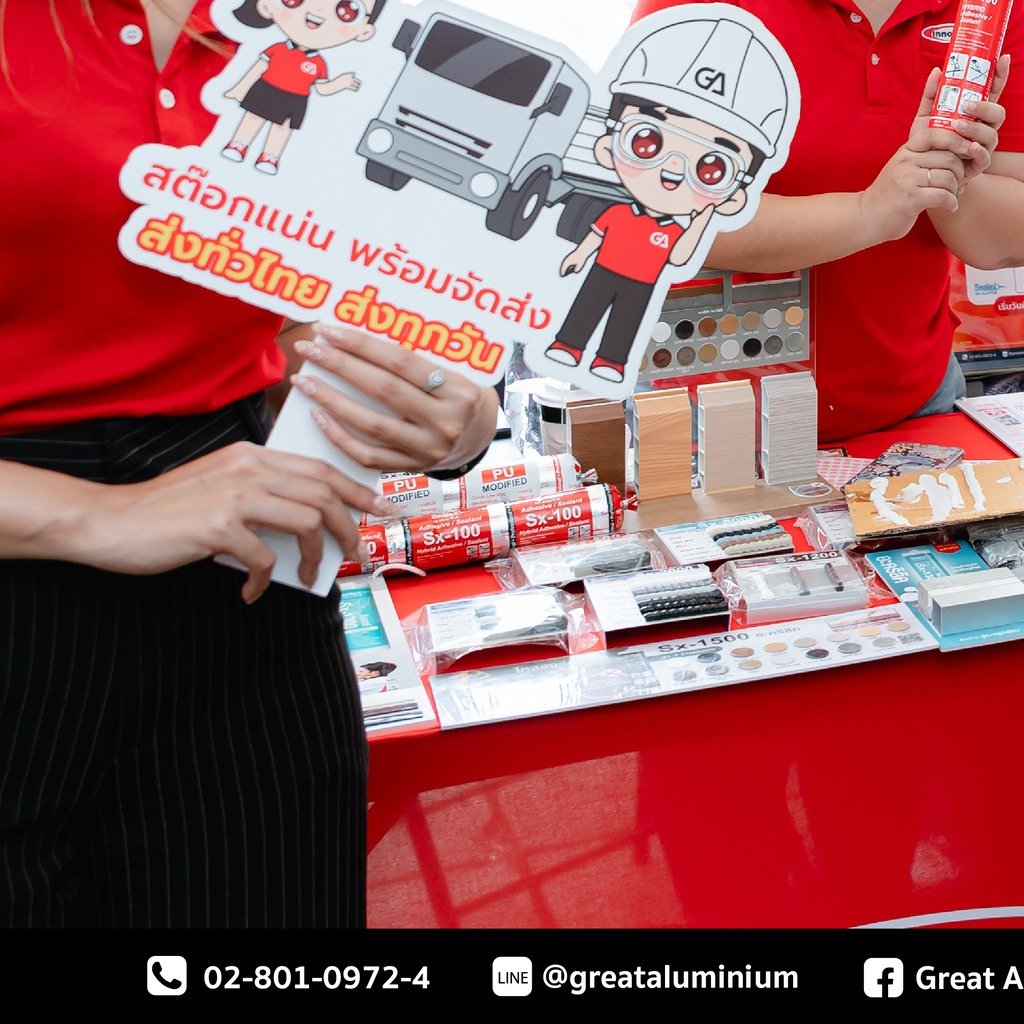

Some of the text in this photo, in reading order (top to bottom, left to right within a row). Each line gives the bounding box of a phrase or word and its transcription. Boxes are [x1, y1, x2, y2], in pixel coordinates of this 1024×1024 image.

[695, 67, 726, 96] GA
[143, 164, 552, 330] สต๊อกแน่น พร้อมจัดส่ง
[650, 232, 669, 248] GA
[137, 213, 505, 374] ส่งทั่วไทย ส่งทุกวัน
[974, 283, 997, 291] Sealex
[492, 467, 514, 479] PU
[394, 478, 417, 492] PU
[482, 477, 527, 492] MODIFIED
[521, 504, 551, 513] Adhesive
[557, 498, 583, 507] Sealant
[418, 521, 450, 531] Adhesive
[456, 516, 483, 525] Sealant
[525, 505, 582, 527] Sx-100
[539, 523, 565, 532] Adhesive
[569, 519, 590, 527] Sealant
[423, 524, 480, 545] Sx-100
[416, 546, 436, 554] Hybrid
[436, 542, 463, 551] Adhesive
[467, 537, 489, 545] Sealant
[658, 633, 749, 652] Sx-1500
